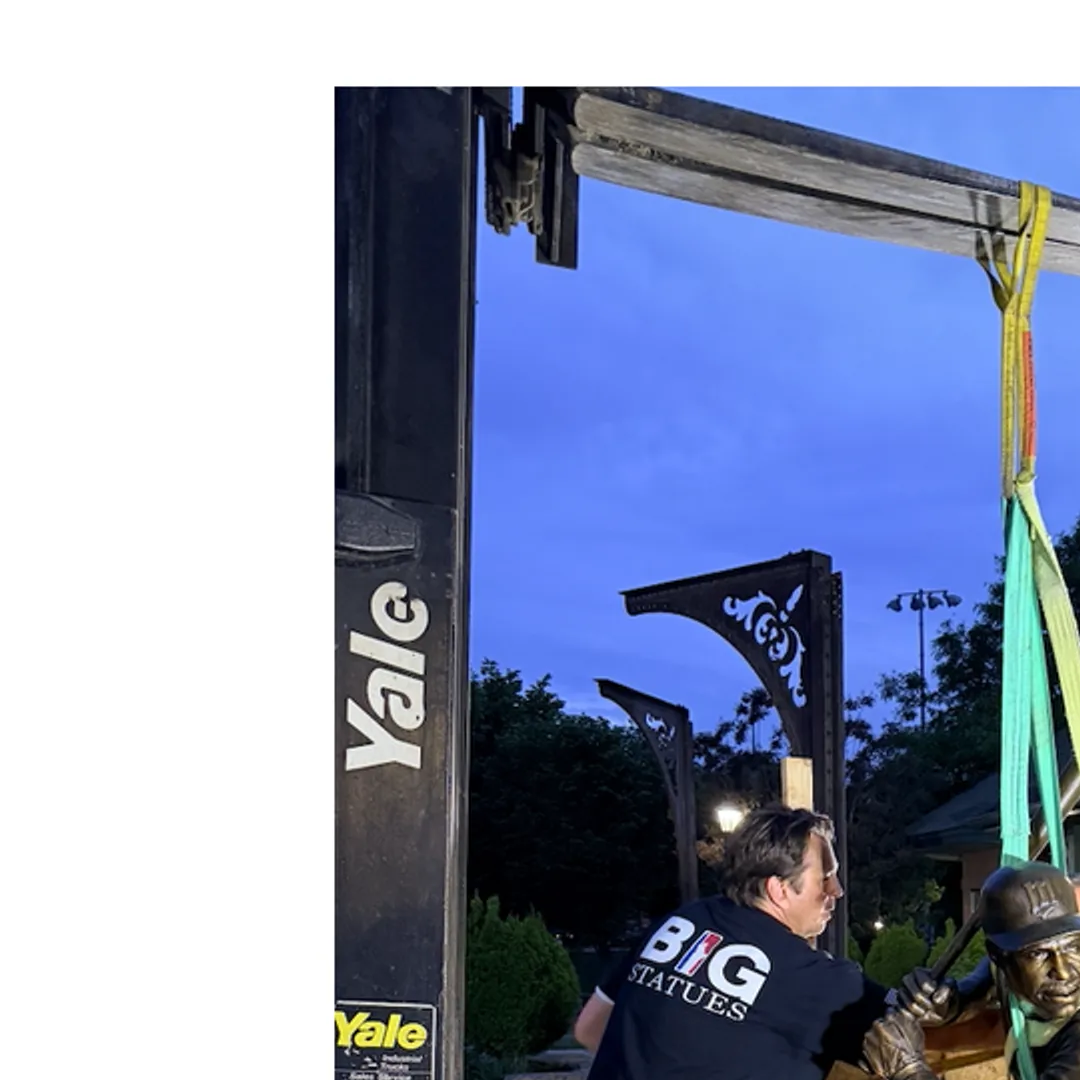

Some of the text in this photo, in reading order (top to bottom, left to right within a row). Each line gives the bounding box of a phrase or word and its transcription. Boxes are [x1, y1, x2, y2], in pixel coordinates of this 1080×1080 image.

[345, 581, 429, 771] Yale
[627, 962, 748, 1021] STATUES
[640, 915, 771, 1006] BIG
[335, 1010, 427, 1050] Yale
